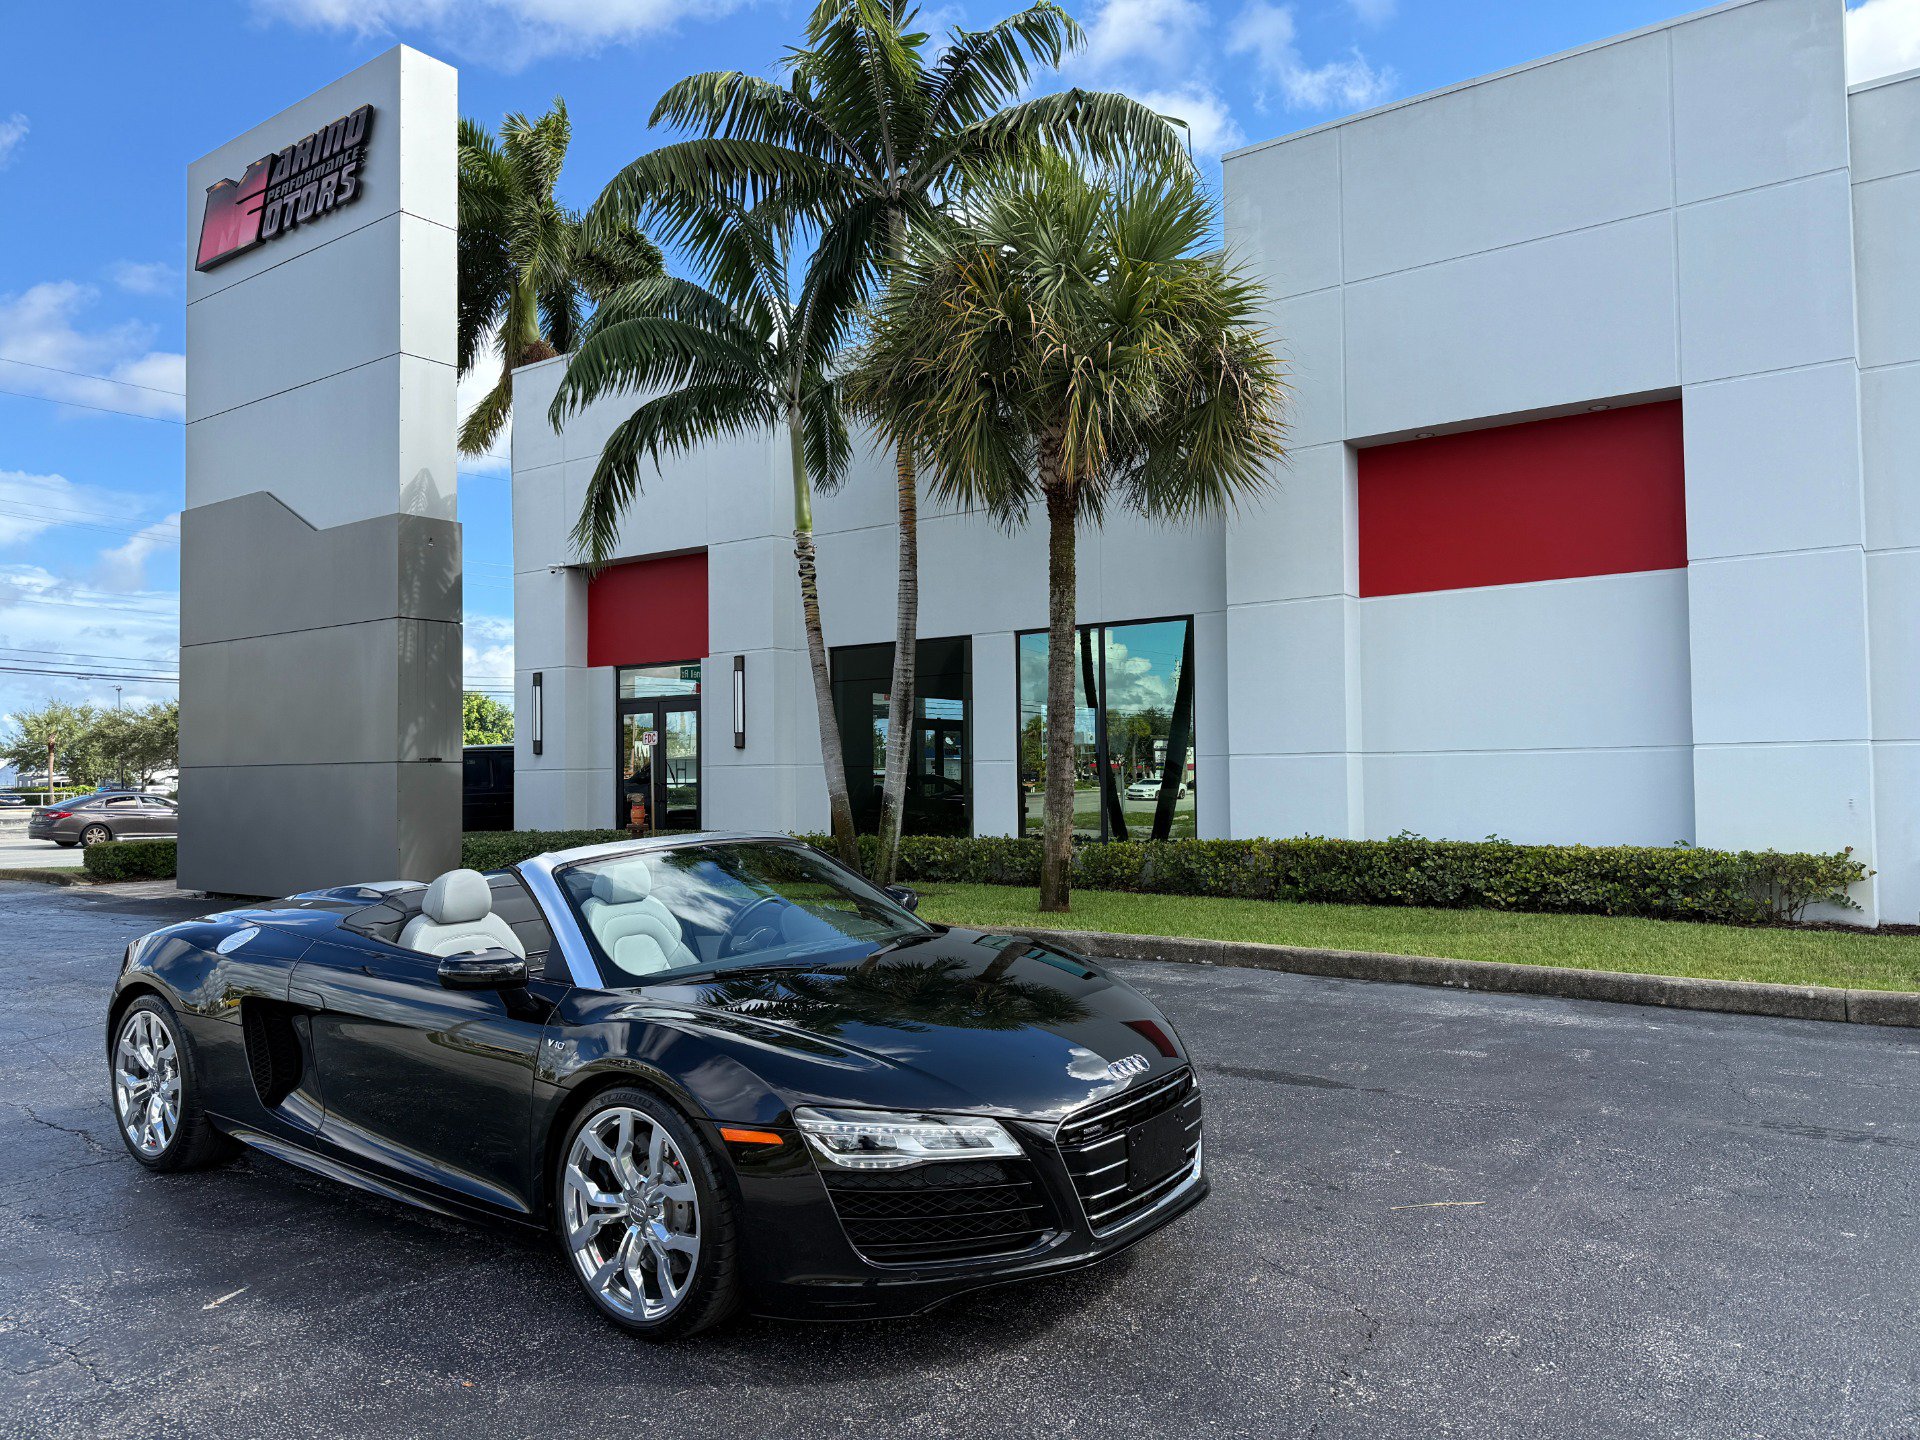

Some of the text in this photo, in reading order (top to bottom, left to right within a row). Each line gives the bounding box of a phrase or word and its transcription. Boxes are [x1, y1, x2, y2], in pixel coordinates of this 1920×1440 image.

[266, 146, 360, 203] PERFORMANCE
[644, 733, 656, 743] FDC
[547, 1038, 566, 1050] V10
